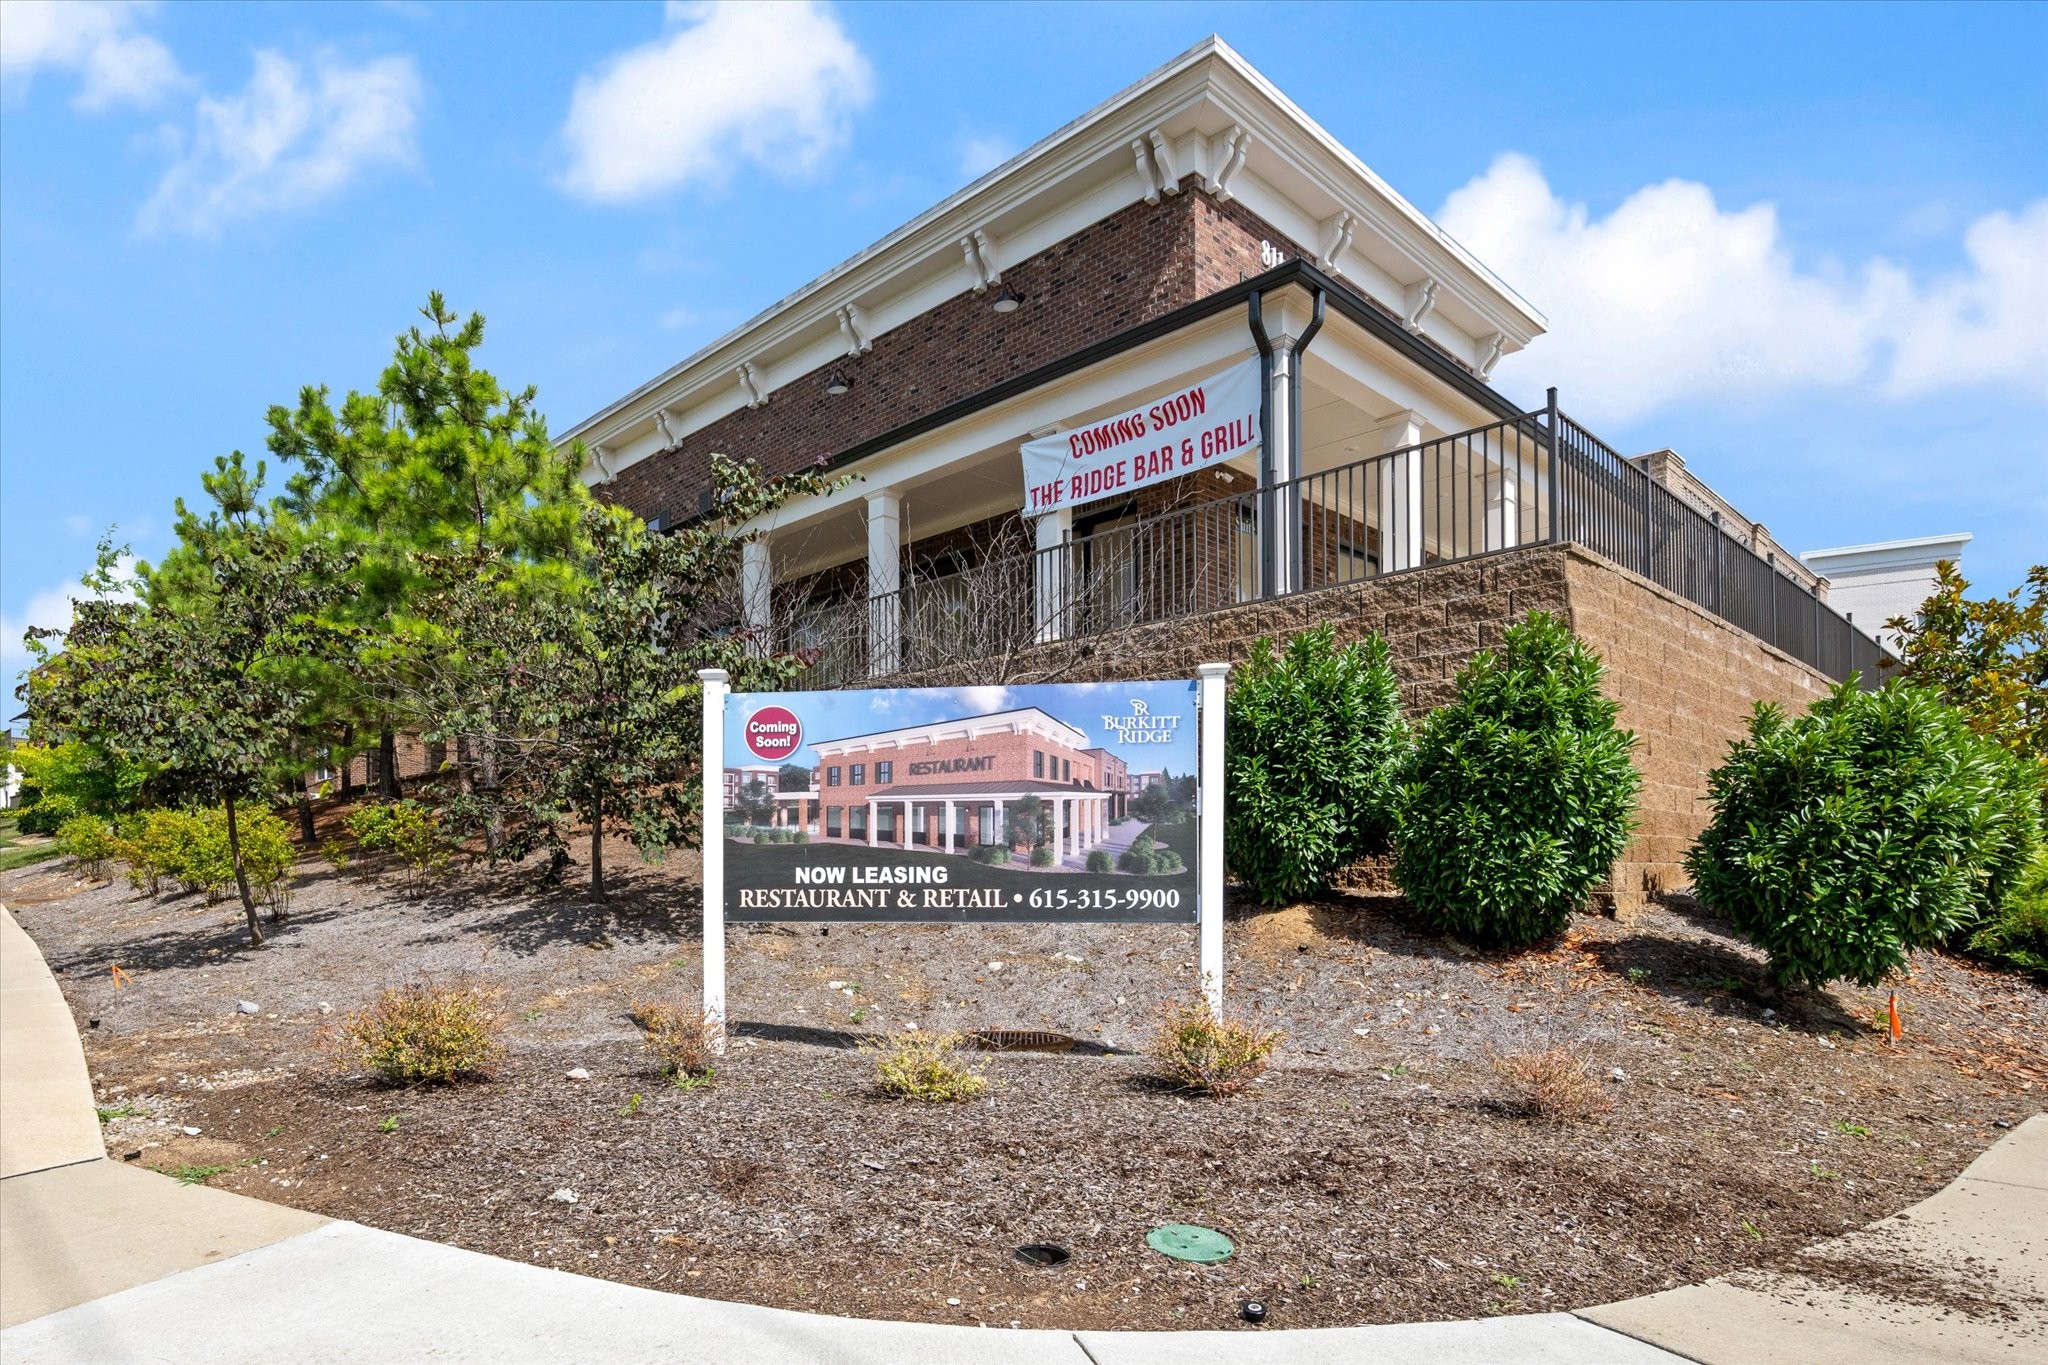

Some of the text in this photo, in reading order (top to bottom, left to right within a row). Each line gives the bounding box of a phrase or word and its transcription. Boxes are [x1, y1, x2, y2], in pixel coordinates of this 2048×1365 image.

[1069, 387, 1206, 459] COMING SOON
[1030, 414, 1255, 508] THE RIDGE BAR & GRILL
[750, 721, 797, 735] Coming
[1101, 715, 1181, 731] BURKITT
[756, 736, 791, 748] Soon!
[1117, 727, 1172, 744] RIDGE
[909, 755, 995, 776] RESTAURANT
[795, 866, 948, 884] NOW LEASING
[739, 888, 1180, 909] RESTAURANT & RETAIL 615-315-9900
